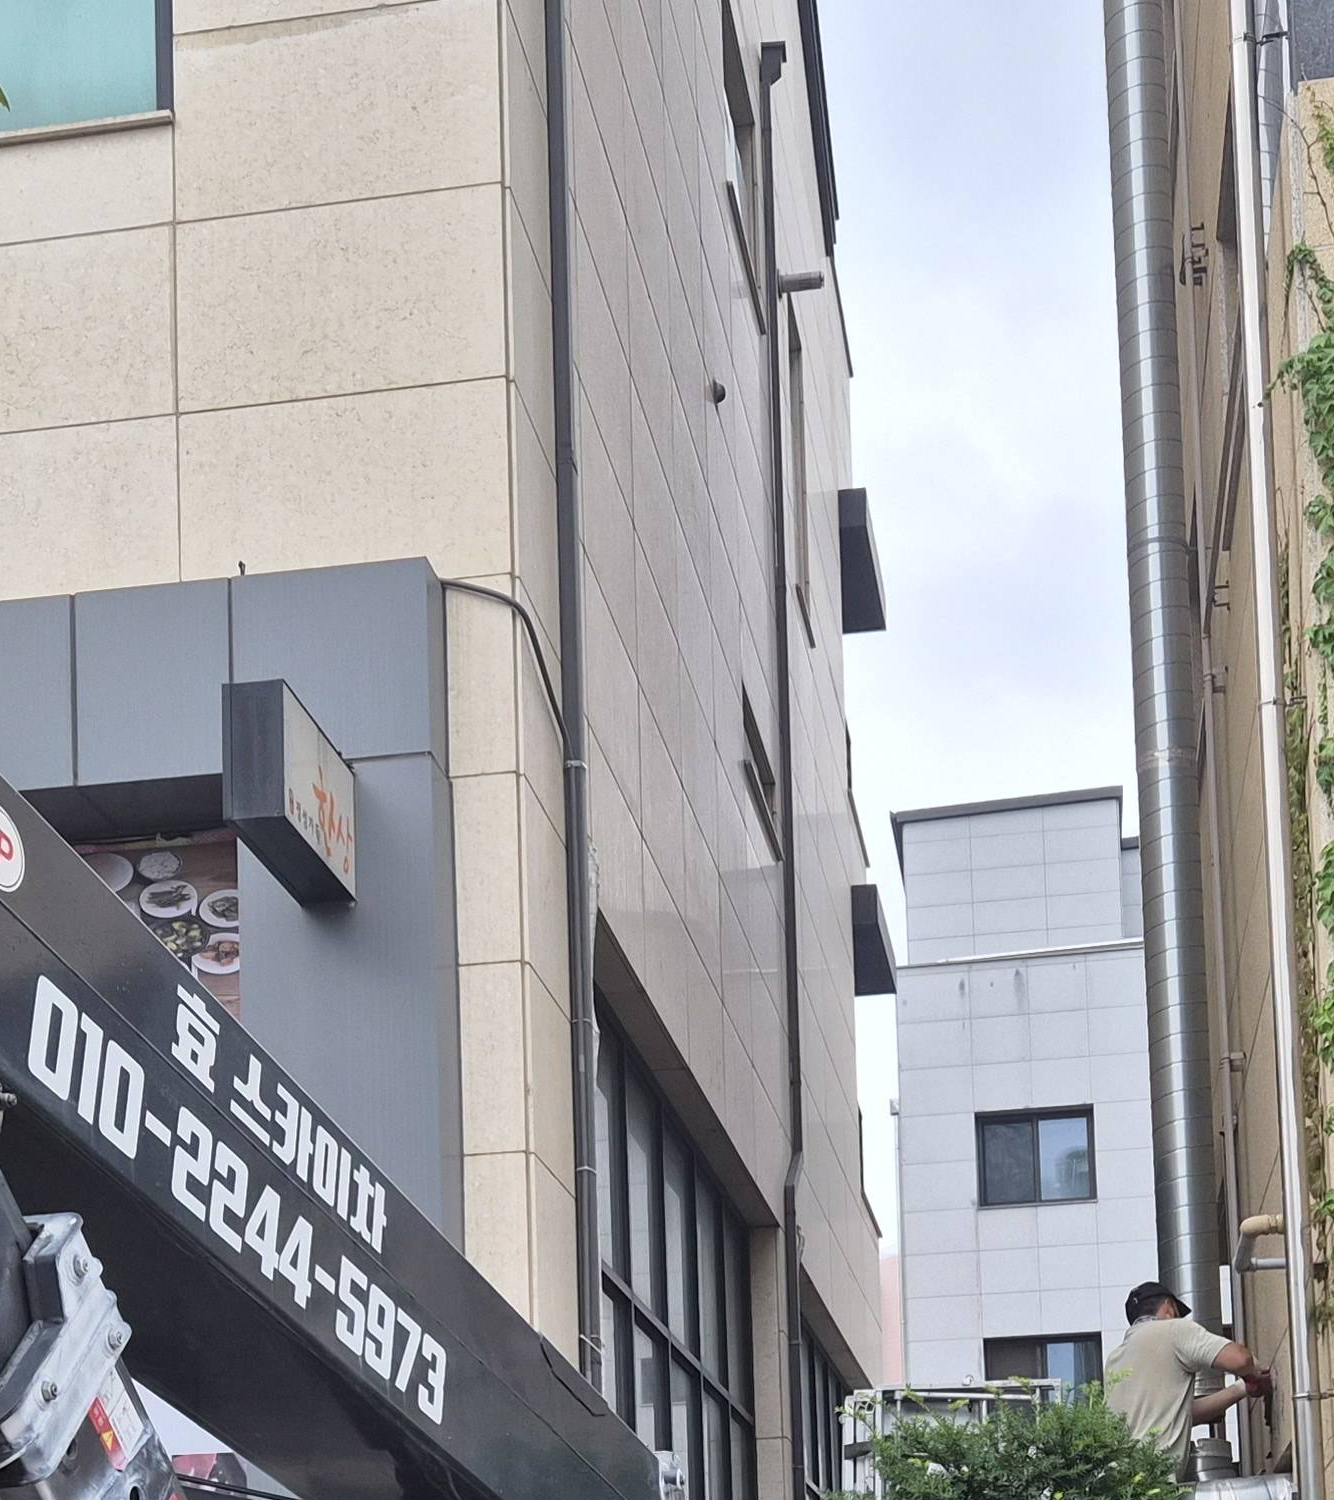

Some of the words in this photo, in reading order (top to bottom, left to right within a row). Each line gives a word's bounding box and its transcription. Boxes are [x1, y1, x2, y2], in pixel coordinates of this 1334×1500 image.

[27, 975, 449, 1426] 010-2244-5973
[171, 984, 221, 1093] 효
[230, 1054, 389, 1255] 스카이차
